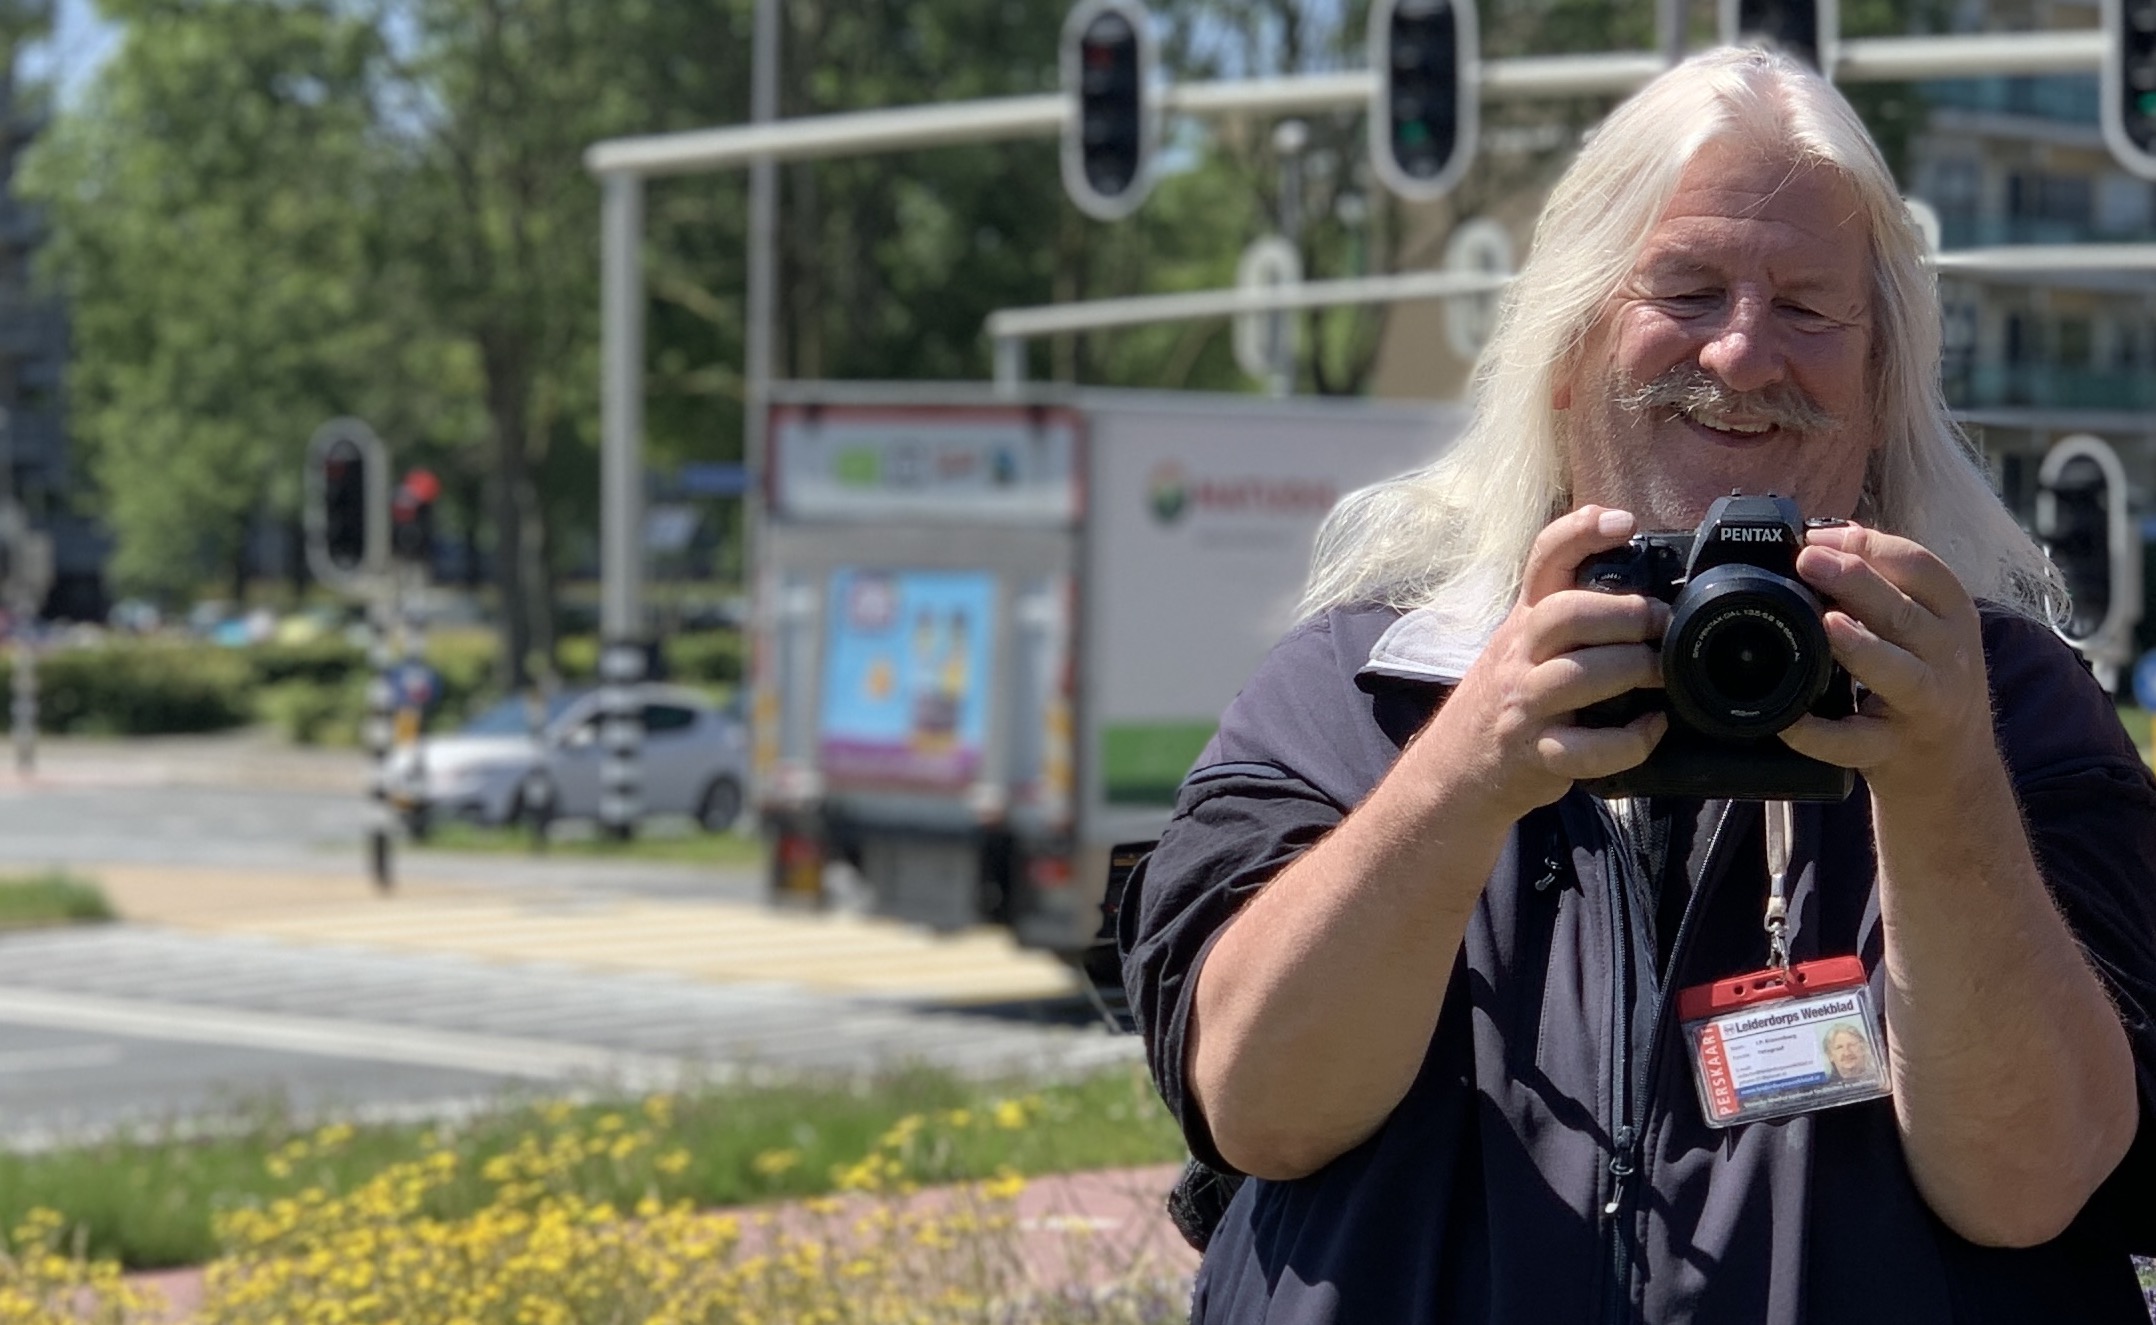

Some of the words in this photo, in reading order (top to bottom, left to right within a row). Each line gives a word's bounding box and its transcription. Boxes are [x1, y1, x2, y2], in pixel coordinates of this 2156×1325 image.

[1720, 527, 1783, 542] PENTAX
[1735, 1012, 1800, 1034] Leiderdorps
[1800, 999, 1854, 1020] Weekblad
